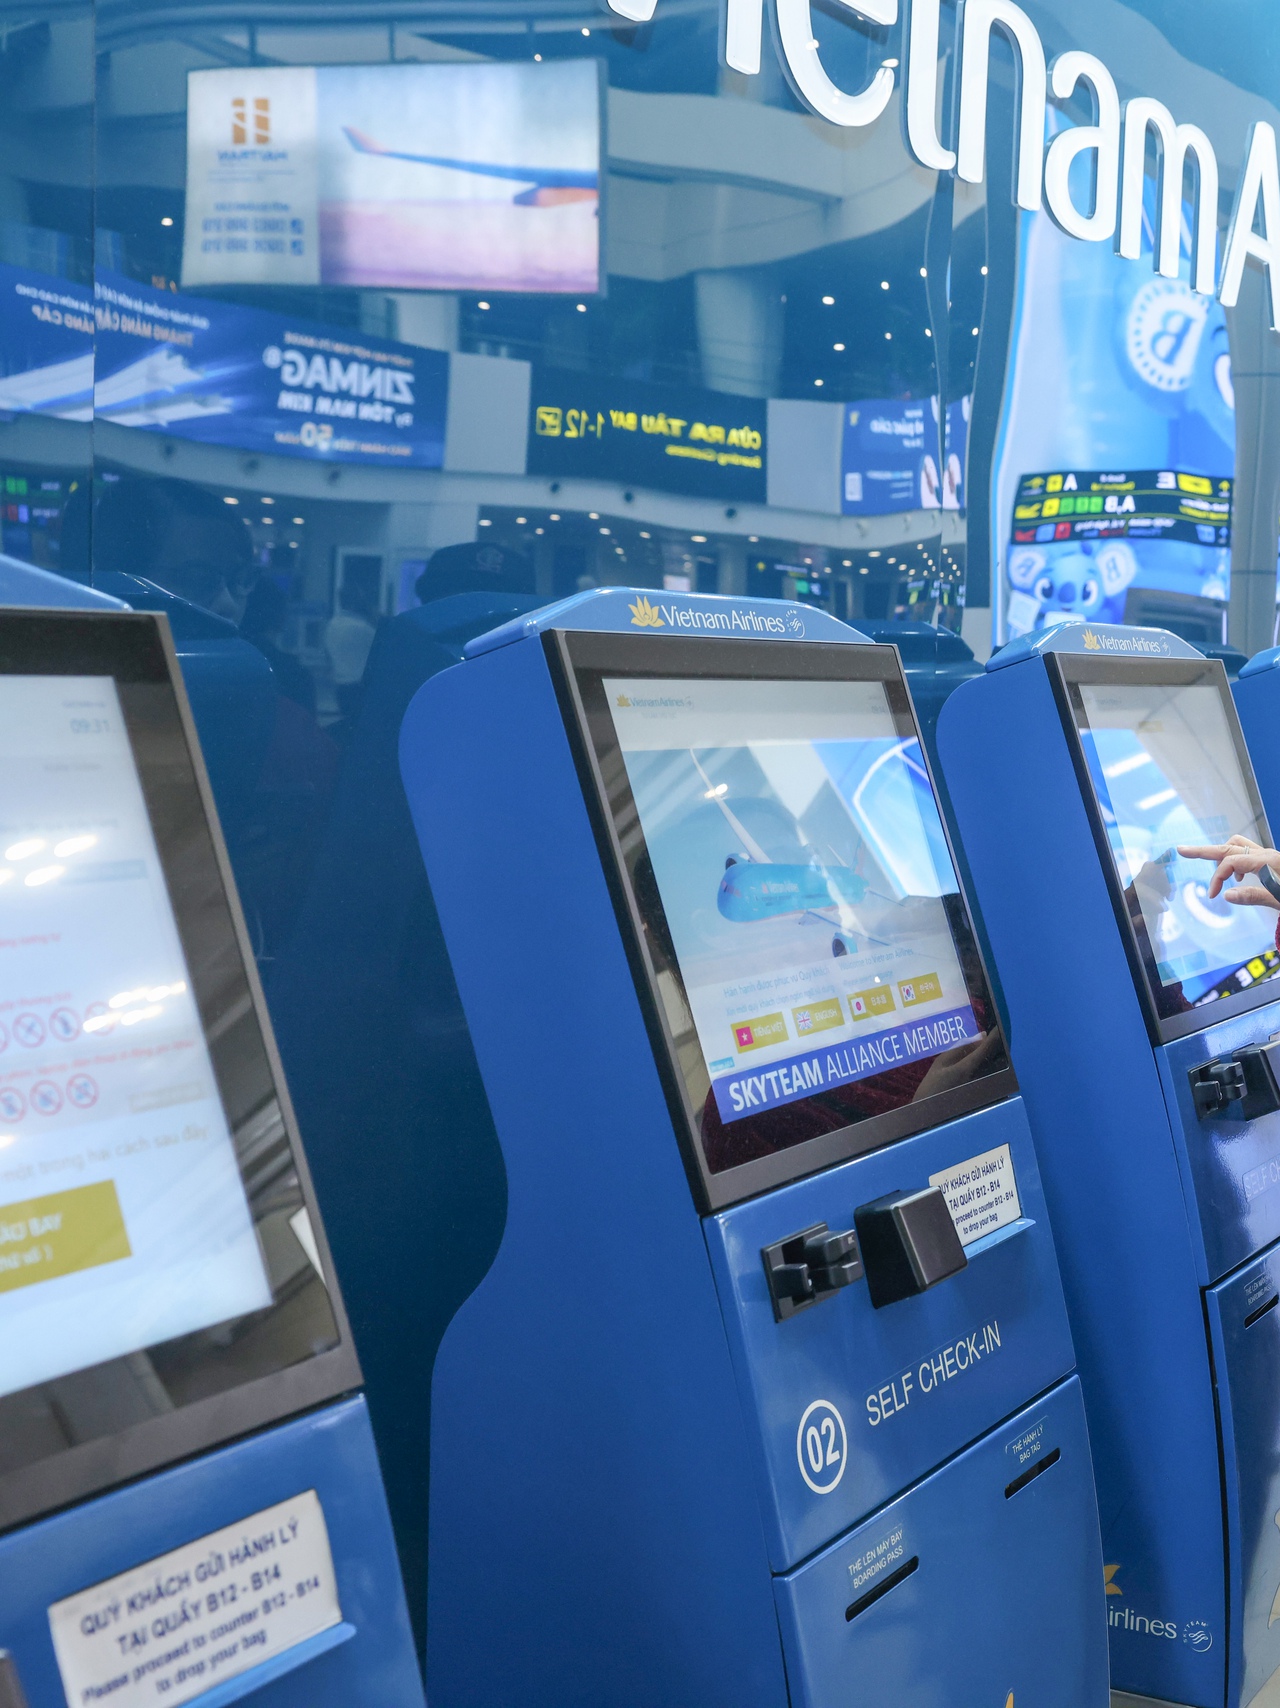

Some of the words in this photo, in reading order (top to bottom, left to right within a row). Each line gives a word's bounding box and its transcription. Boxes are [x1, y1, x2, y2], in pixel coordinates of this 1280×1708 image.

[603, 0, 1218, 296] etnam
[661, 605, 731, 630] Vietnam
[731, 609, 786, 633] Airlines
[1097, 634, 1133, 651] Vietnam
[1132, 636, 1161, 653] Airlines
[814, 1008, 837, 1021] ENGLISH
[728, 1058, 824, 1112] SKYTEAM
[826, 1034, 904, 1081] ALLIANCE
[902, 1015, 968, 1056] MEMBER
[950, 1172, 971, 1191] KHÁCH
[997, 1155, 1005, 1170] LÝ
[1245, 1165, 1268, 1198] SELF
[948, 1198, 959, 1212] TẠI
[976, 1185, 987, 1199] B12
[990, 1179, 1001, 1193] B14
[955, 1210, 973, 1226] proceed
[973, 1207, 979, 1217] to
[979, 1201, 995, 1214] counter
[994, 1196, 1004, 1206] B12
[1005, 1190, 1014, 1201] B14
[963, 1226, 968, 1235] to
[969, 1220, 979, 1232] drop
[979, 1217, 989, 1229] your
[989, 1213, 998, 1224] bag
[866, 1371, 914, 1427] SELF
[918, 1320, 1002, 1393] CHECK-IN
[806, 1417, 841, 1473] 02
[1019, 1450, 1031, 1464] BAG
[1030, 1442, 1041, 1456] TAG
[126, 1569, 191, 1617] KHÁCH
[279, 1516, 300, 1545] LÝ
[862, 1549, 877, 1567] LÊN
[890, 1529, 903, 1548] BAY
[853, 1556, 888, 1589] BOARDING
[887, 1545, 904, 1564] PASS
[206, 1583, 237, 1613] B12
[250, 1563, 281, 1592] B14
[81, 1672, 128, 1703] Please
[132, 1642, 190, 1684] proceed
[192, 1633, 207, 1650] to
[209, 1608, 259, 1641] counter
[261, 1592, 286, 1616] B12
[296, 1575, 320, 1600] B14
[1107, 1605, 1178, 1639] irlines
[156, 1678, 171, 1695] to
[174, 1658, 206, 1685] drop
[210, 1642, 240, 1671] your
[241, 1628, 267, 1651] bag
